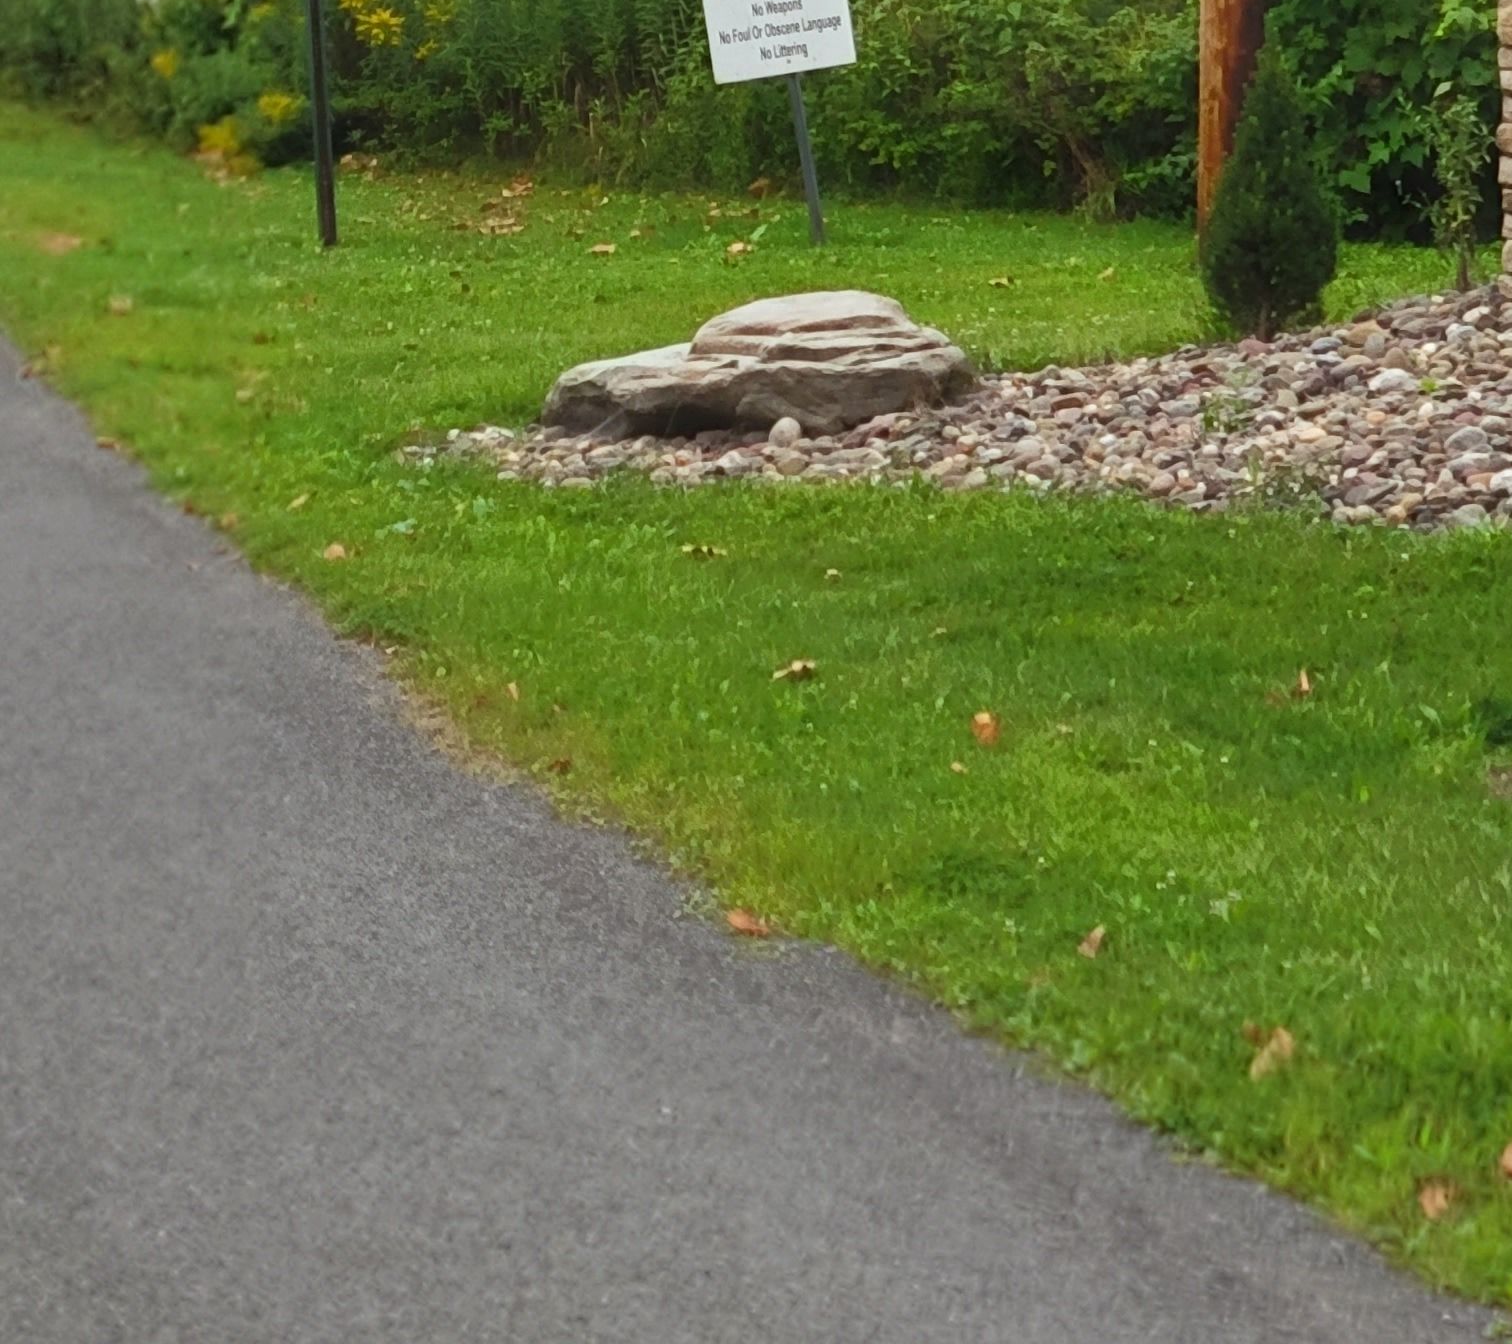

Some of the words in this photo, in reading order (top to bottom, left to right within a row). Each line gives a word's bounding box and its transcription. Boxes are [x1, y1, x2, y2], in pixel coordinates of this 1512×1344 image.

[751, 3, 764, 16] No
[764, 0, 803, 16] Weapons
[719, 31, 731, 45] No
[732, 27, 751, 43] Foul
[752, 26, 762, 39] Or
[764, 22, 800, 38] Obscene
[801, 15, 841, 33] Language
[760, 47, 772, 60] No
[773, 42, 808, 58] Littering
